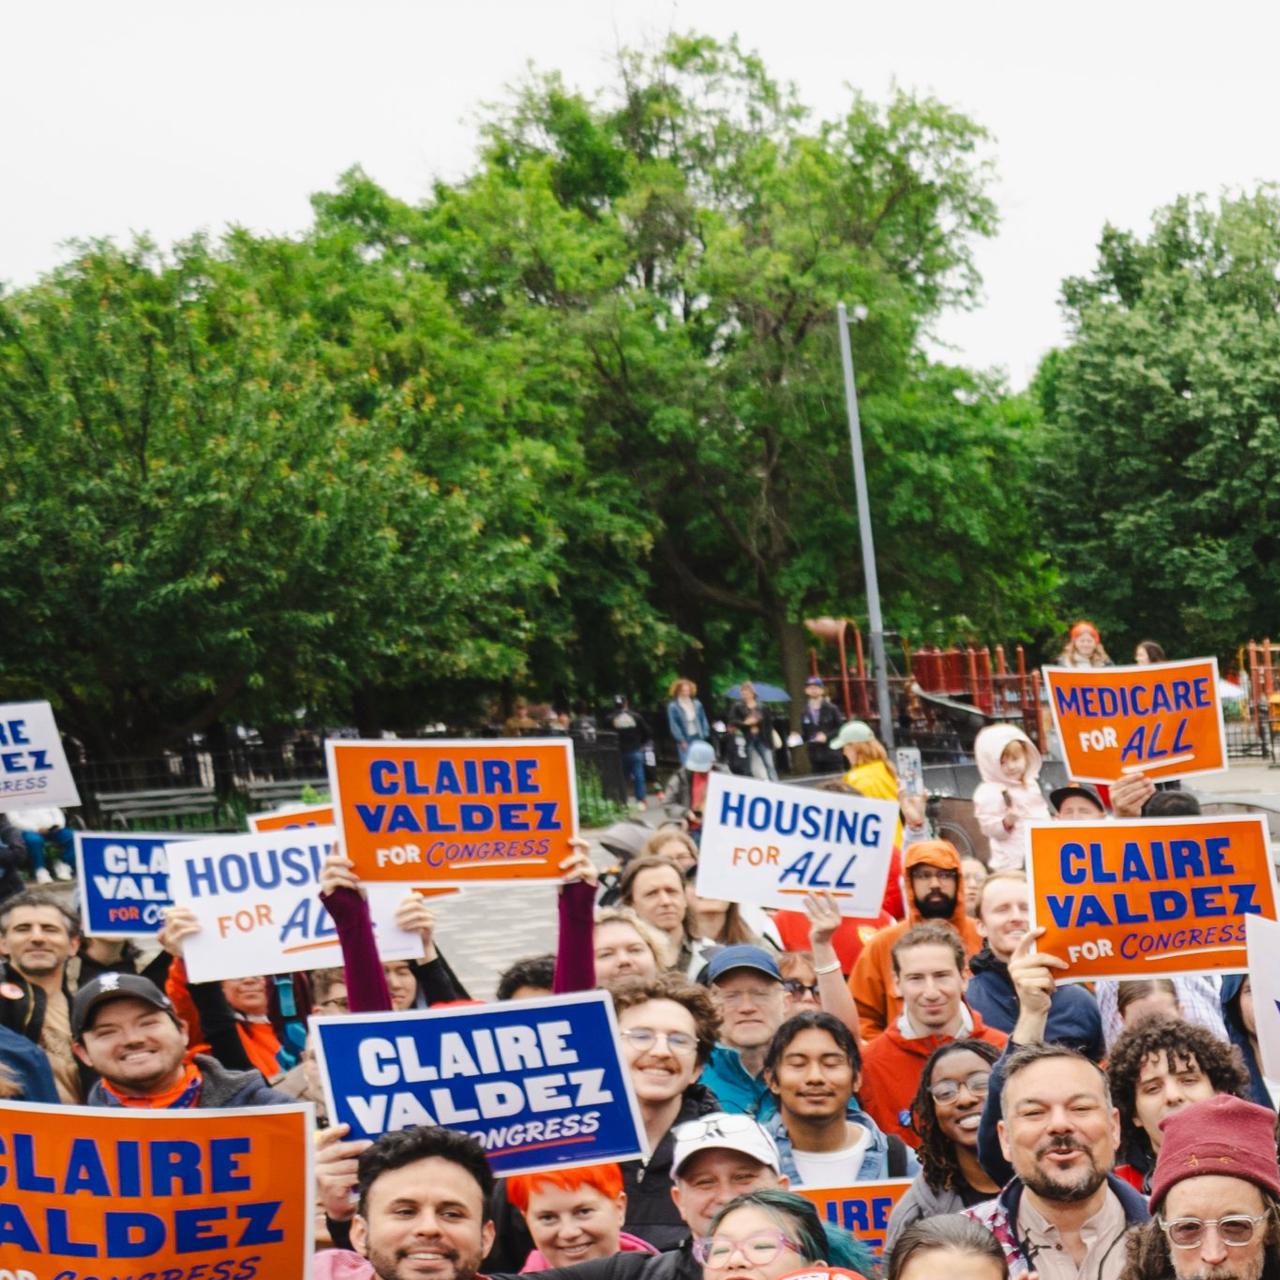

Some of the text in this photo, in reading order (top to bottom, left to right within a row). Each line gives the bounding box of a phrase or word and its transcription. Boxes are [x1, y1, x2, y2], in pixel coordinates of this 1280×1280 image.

[1054, 677, 1212, 718] MEDICARE
[1078, 724, 1194, 763] FOR ALL
[369, 759, 540, 794] CLAIRE
[355, 802, 562, 833] VALDEZ
[718, 790, 882, 849] HOUSING
[103, 845, 169, 874] CLA
[186, 845, 334, 897] HOUSI
[376, 844, 421, 868] FOR
[733, 845, 857, 890] FOR ALL
[1060, 837, 1235, 884] CLAIRE
[93, 876, 171, 900] VAL
[1047, 883, 1262, 930] VALDEZ
[108, 907, 139, 922] FOR
[217, 904, 273, 938] FOR
[279, 898, 339, 943] AL
[1068, 938, 1114, 962] FOR
[358, 1020, 579, 1088] CLAIRE
[347, 1067, 614, 1134] VALDEZ
[466, 1112, 601, 1148] ONGRESS
[0, 1135, 252, 1199] LAIRE
[0, 1200, 285, 1260] ALDEZ
[826, 1196, 893, 1236] IRE
